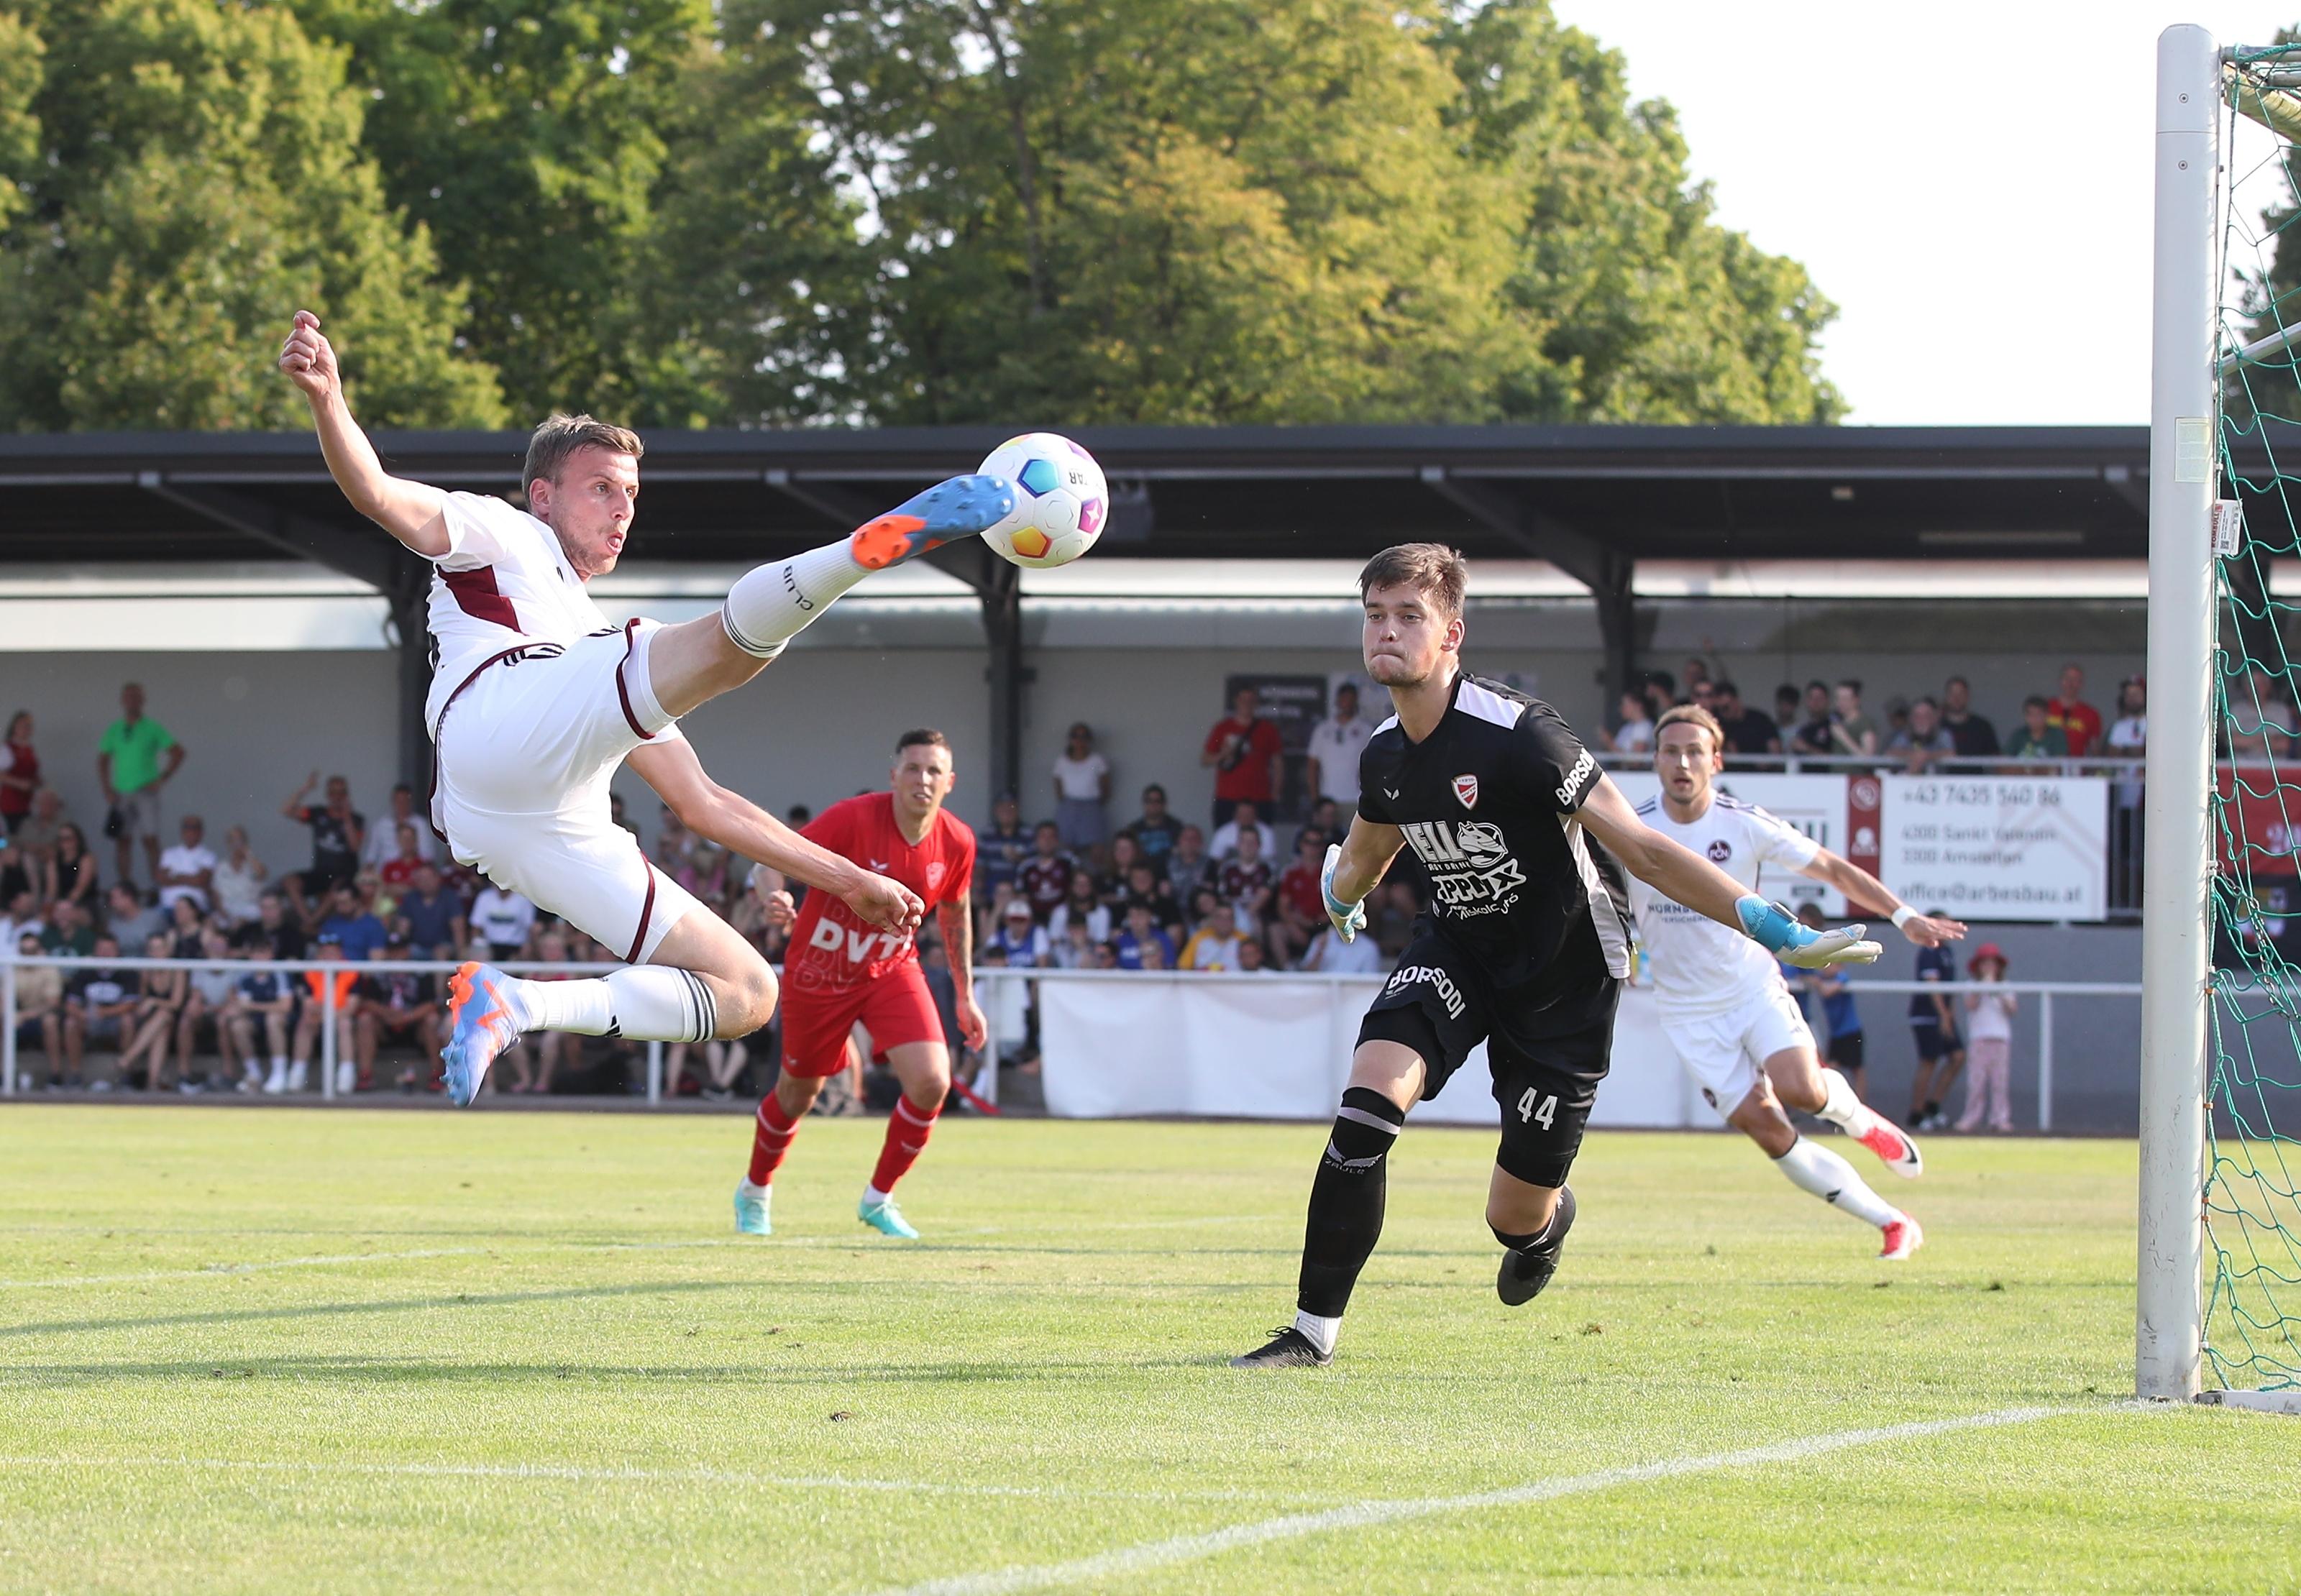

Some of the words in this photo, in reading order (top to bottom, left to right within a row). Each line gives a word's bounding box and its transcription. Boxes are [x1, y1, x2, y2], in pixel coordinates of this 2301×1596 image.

[810, 917, 908, 964] DVT
[1388, 966, 1466, 1020] BORSODI
[1517, 1086, 1558, 1131] 44
